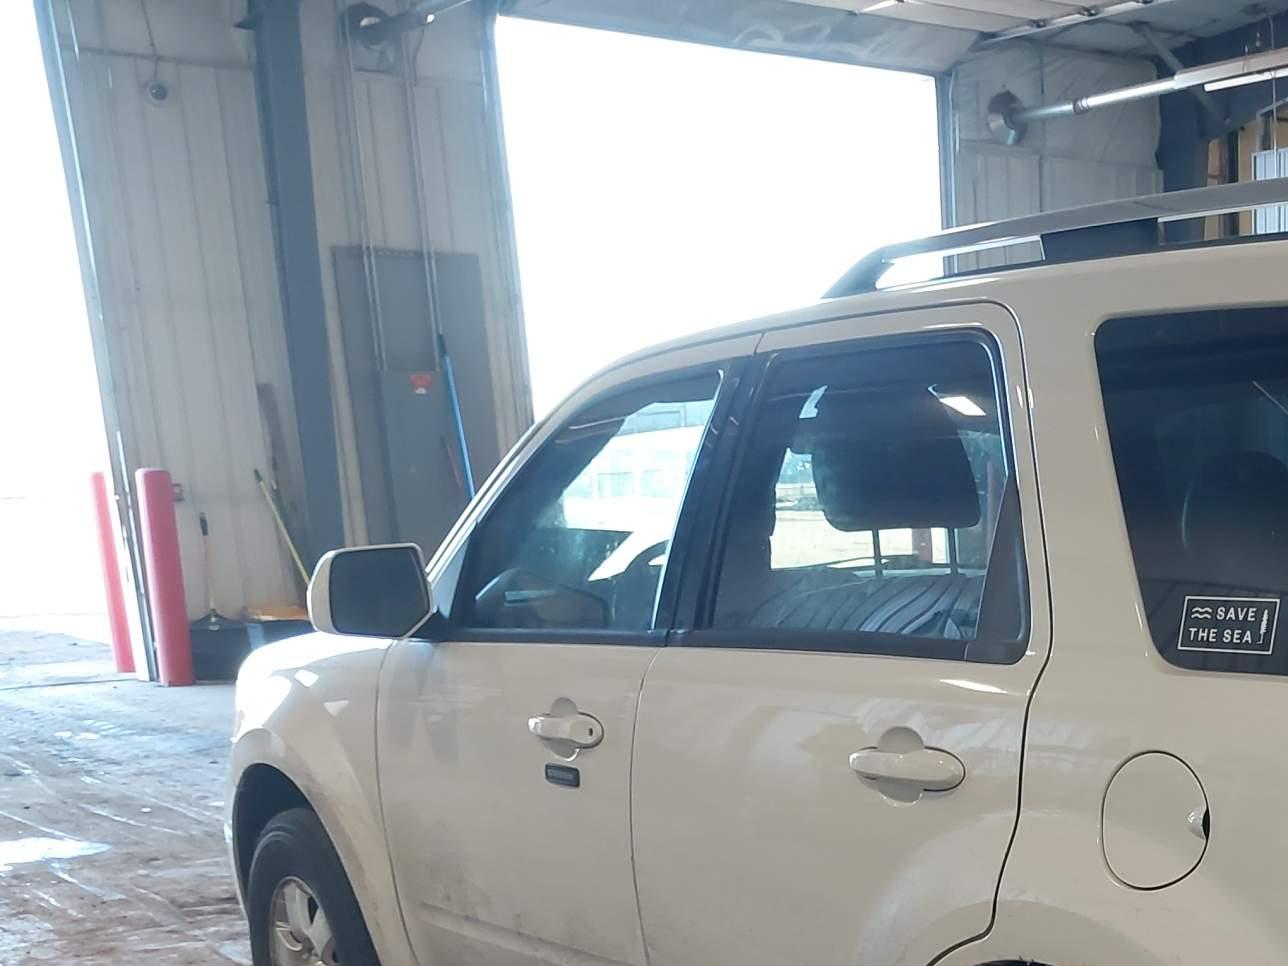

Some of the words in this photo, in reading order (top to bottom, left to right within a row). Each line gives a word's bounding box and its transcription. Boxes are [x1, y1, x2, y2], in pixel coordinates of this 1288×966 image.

[1216, 606, 1257, 621] SAVE
[1188, 627, 1218, 642] THE
[1222, 629, 1252, 644] SEA
